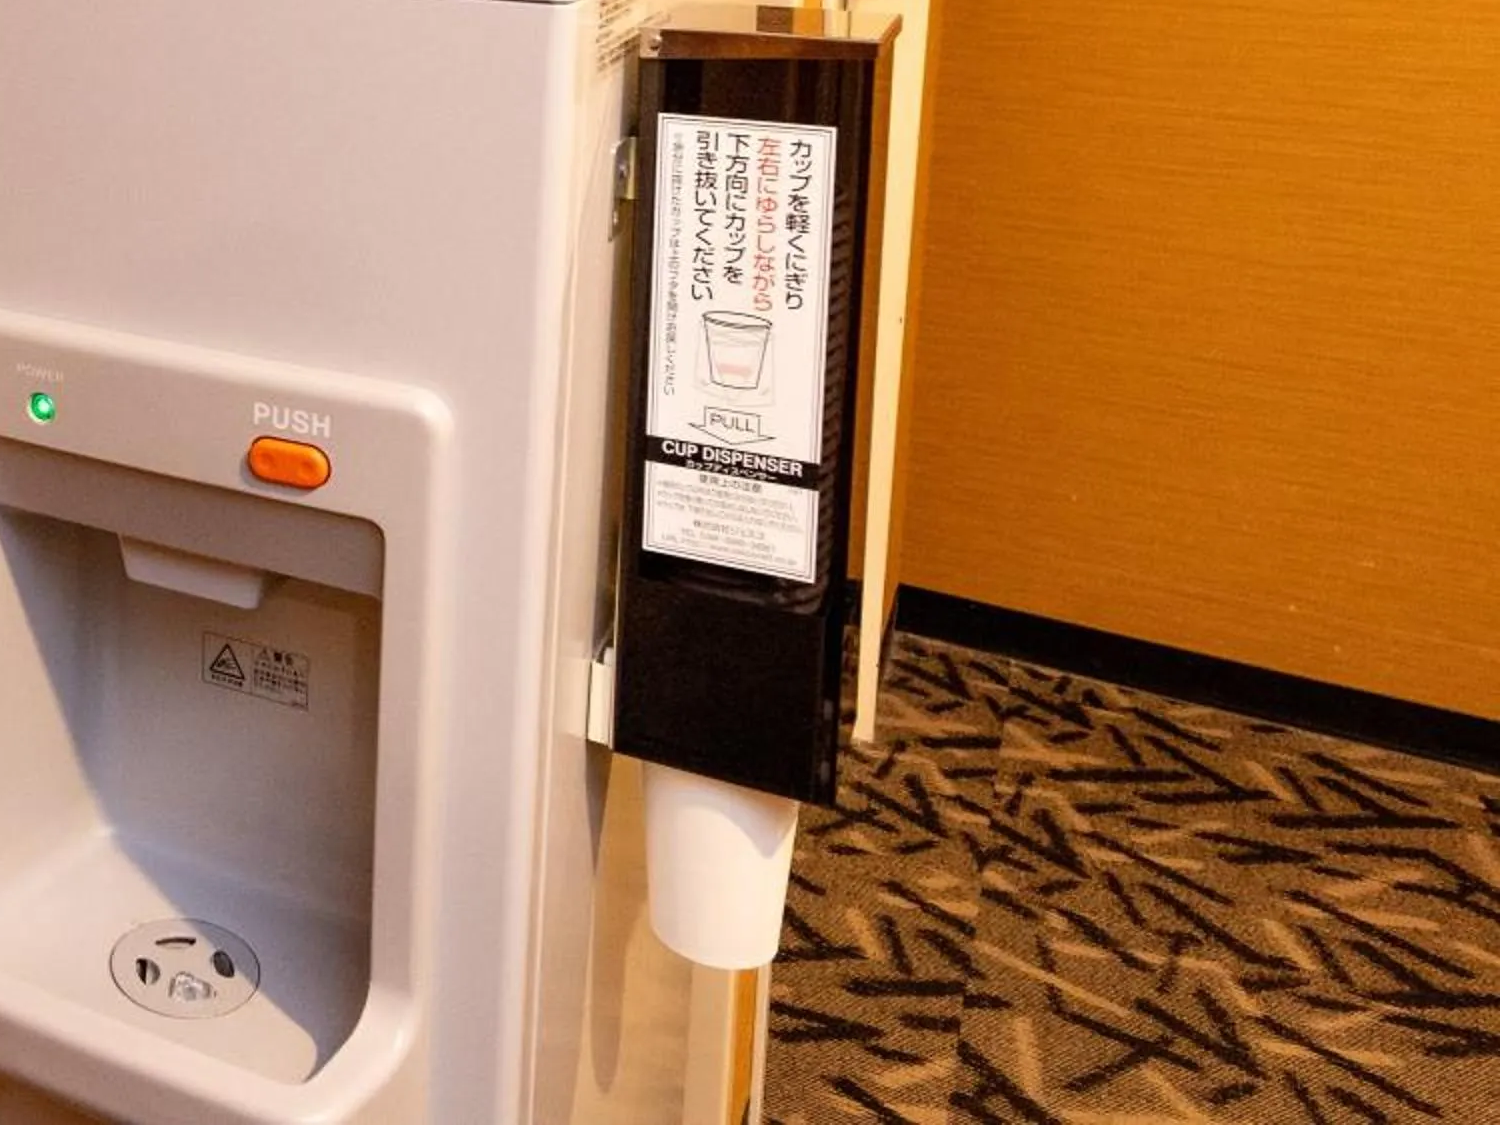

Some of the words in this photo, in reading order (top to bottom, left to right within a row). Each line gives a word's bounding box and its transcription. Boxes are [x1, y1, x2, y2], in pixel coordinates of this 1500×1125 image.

[691, 130, 719, 301] 引き抜いてください
[723, 132, 752, 285] 下方向にカップを
[752, 136, 782, 312] 左右にゆらしながら
[785, 139, 813, 310] カップを軽くにぎり
[253, 402, 332, 438] PUSH
[661, 440, 699, 458] CUP
[701, 448, 803, 478] DISPENSER
[709, 412, 756, 434] PULL
